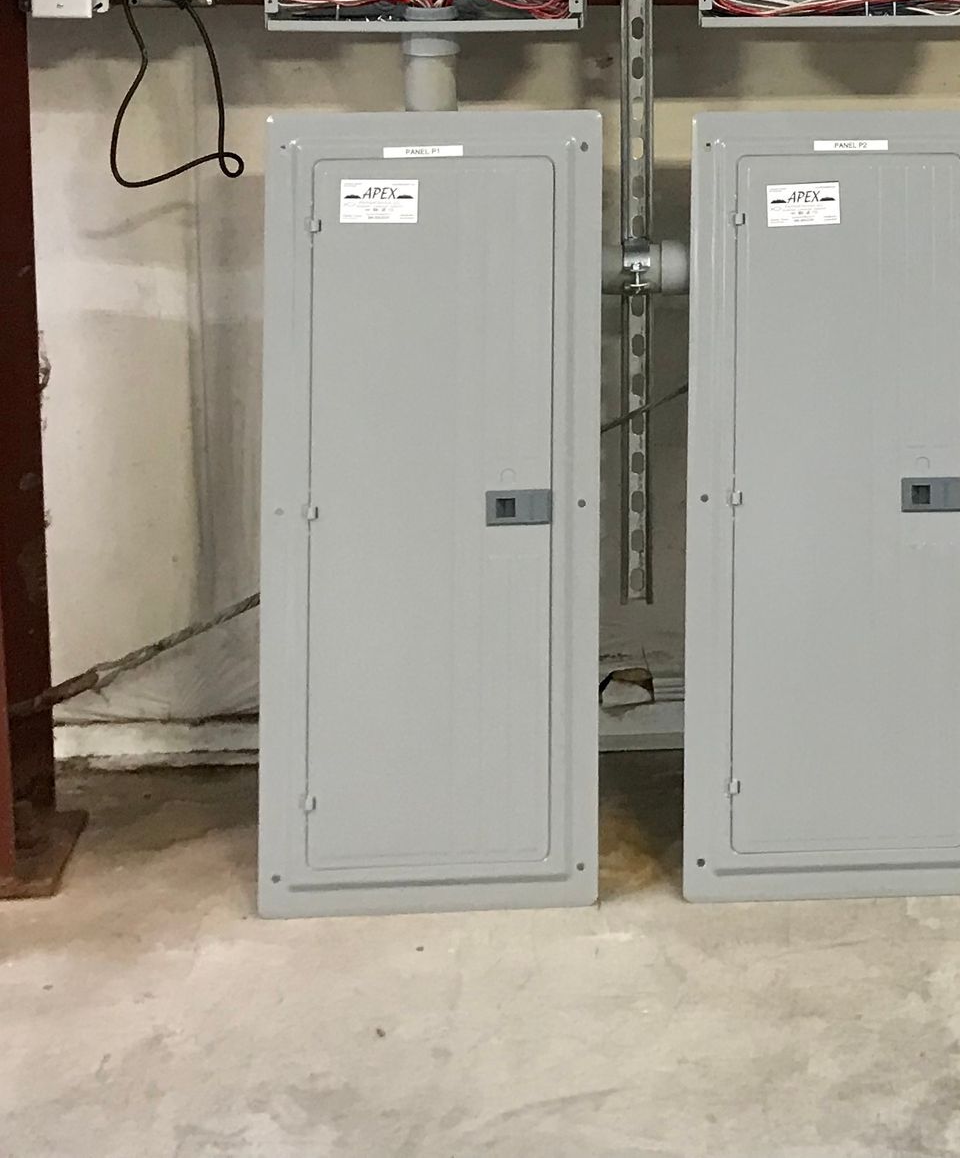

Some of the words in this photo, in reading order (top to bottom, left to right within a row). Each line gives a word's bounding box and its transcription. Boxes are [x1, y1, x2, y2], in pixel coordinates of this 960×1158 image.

[858, 141, 868, 149] P2
[405, 147, 430, 155] PANEL
[362, 186, 398, 200] APEX
[786, 189, 821, 204] APEX
